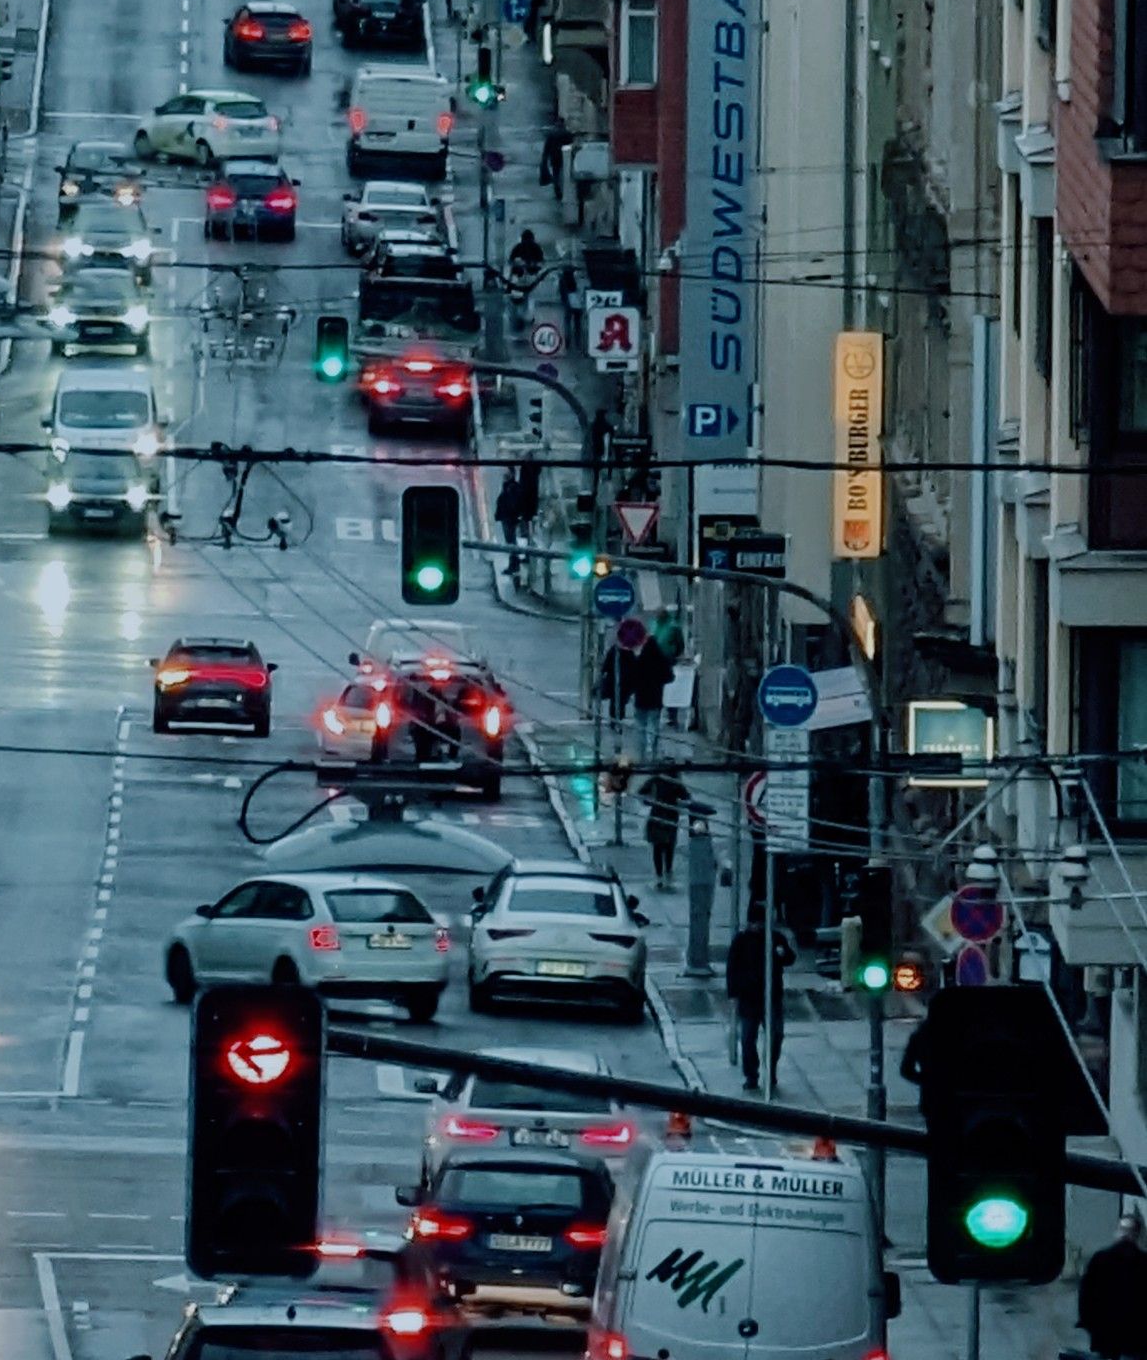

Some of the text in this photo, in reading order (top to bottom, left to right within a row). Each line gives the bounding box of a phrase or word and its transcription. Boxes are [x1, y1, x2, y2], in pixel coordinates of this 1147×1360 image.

[538, 332, 554, 346] 40
[695, 407, 717, 434] P
[848, 389, 869, 462] BURGER
[672, 1169, 844, 1196] MÜLLER & MÜLLER
[670, 1199, 715, 1215] Werbe-
[720, 1202, 744, 1216] und
